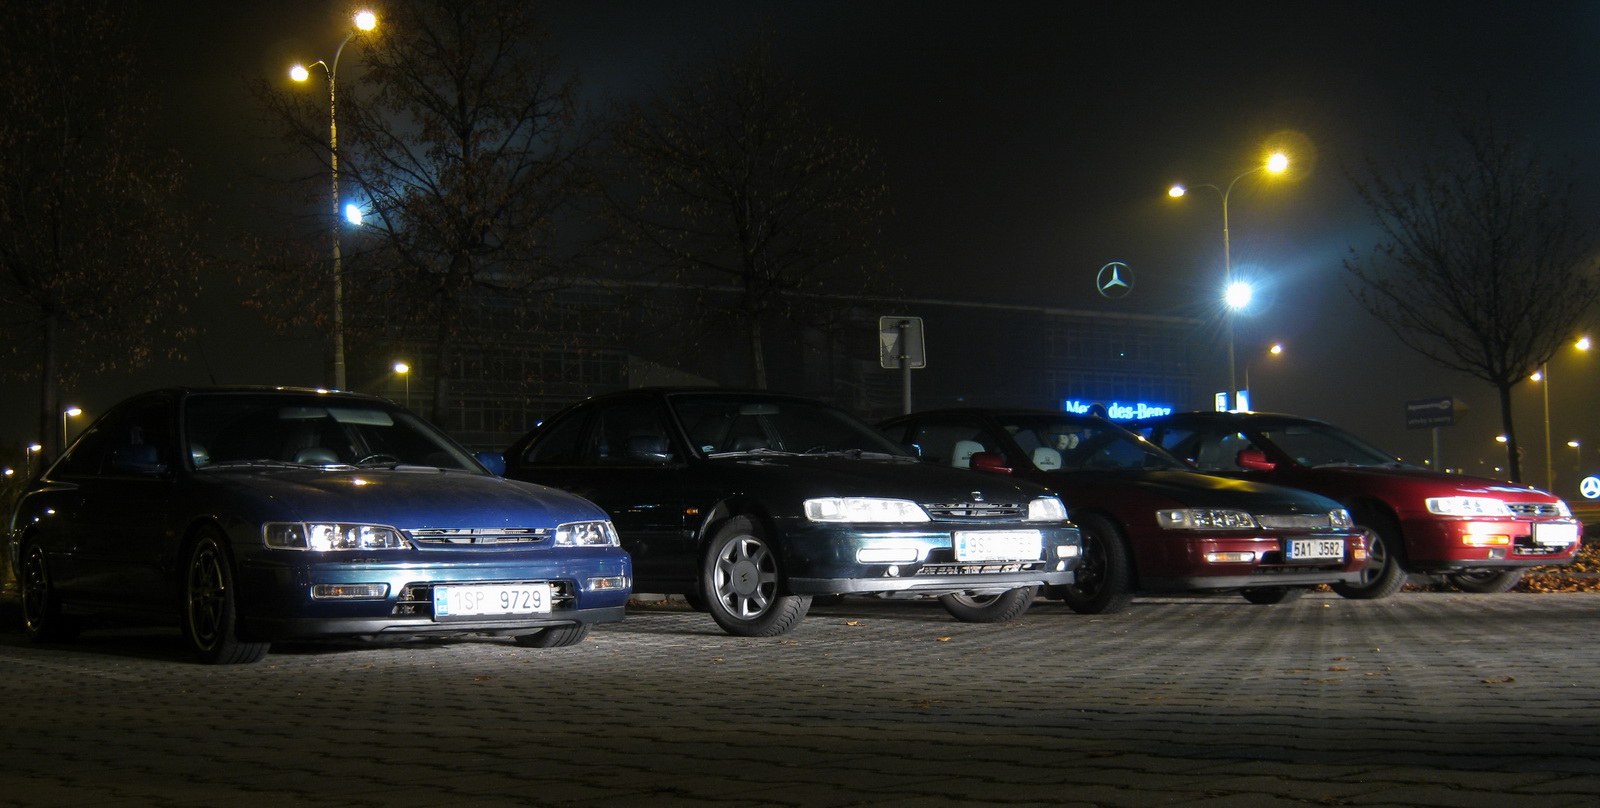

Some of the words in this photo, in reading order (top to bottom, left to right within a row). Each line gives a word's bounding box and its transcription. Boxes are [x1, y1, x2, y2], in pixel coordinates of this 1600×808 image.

[1066, 401, 1171, 419] Medes-Benz
[1294, 542, 1312, 556] 5A1
[1319, 542, 1340, 556] 3582
[454, 591, 485, 610] 1SP
[500, 590, 541, 609] 9729
